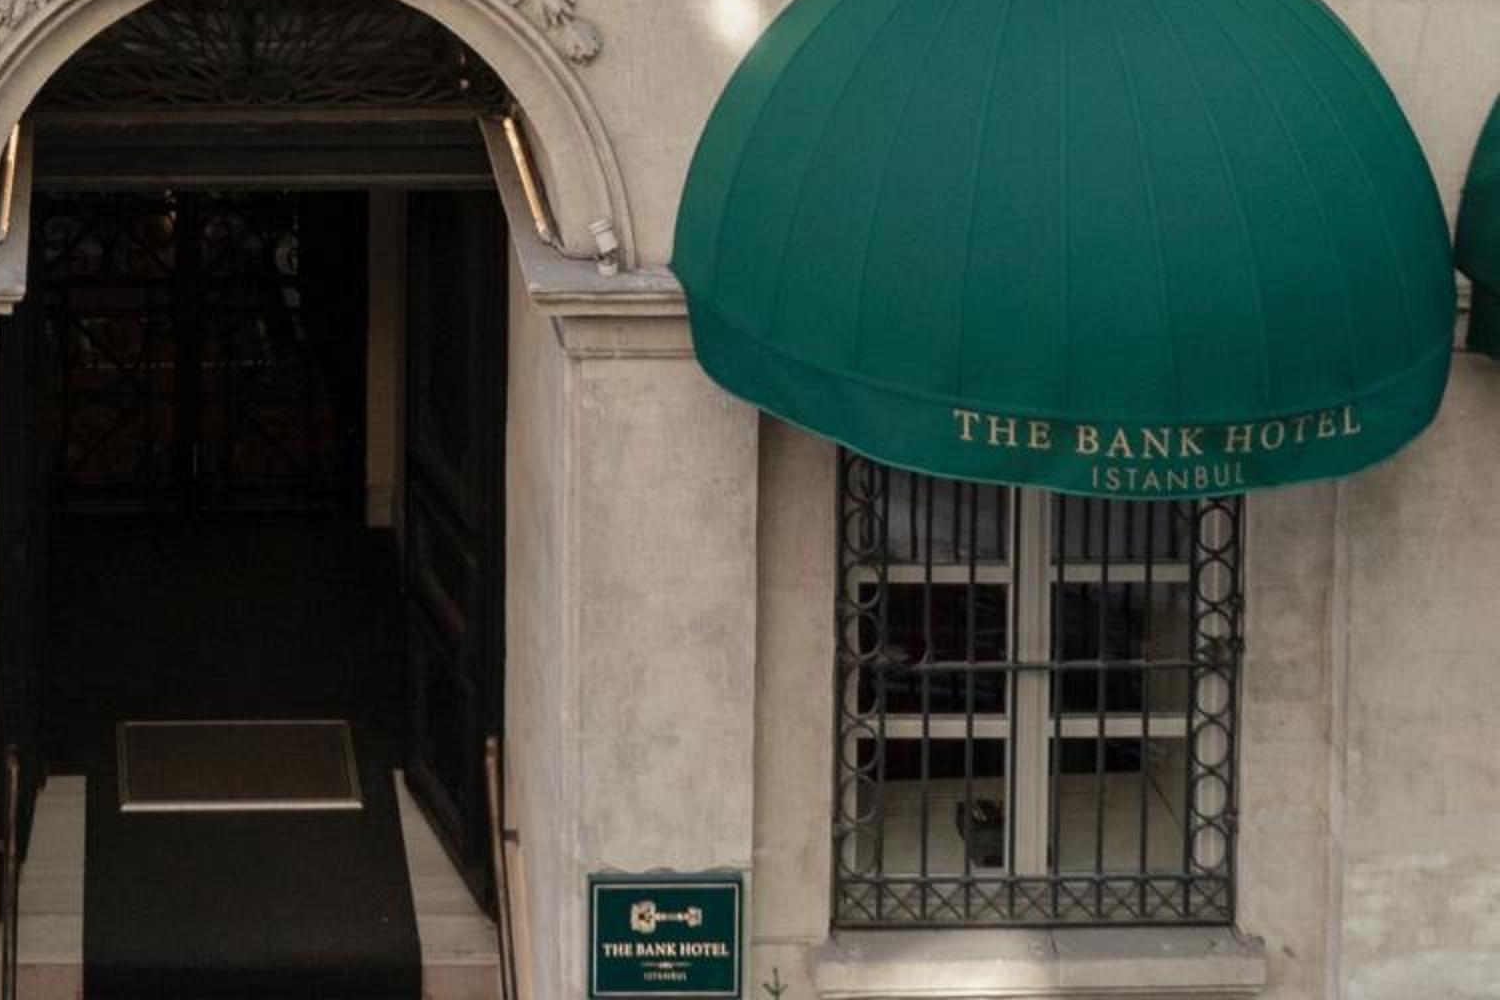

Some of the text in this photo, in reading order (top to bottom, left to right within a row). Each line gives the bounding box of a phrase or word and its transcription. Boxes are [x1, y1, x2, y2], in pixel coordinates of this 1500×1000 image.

[953, 405, 1362, 458] THE BANK HOTEL
[1092, 461, 1245, 491] ISTANBUL
[603, 942, 730, 957] THE BANK HOTEL
